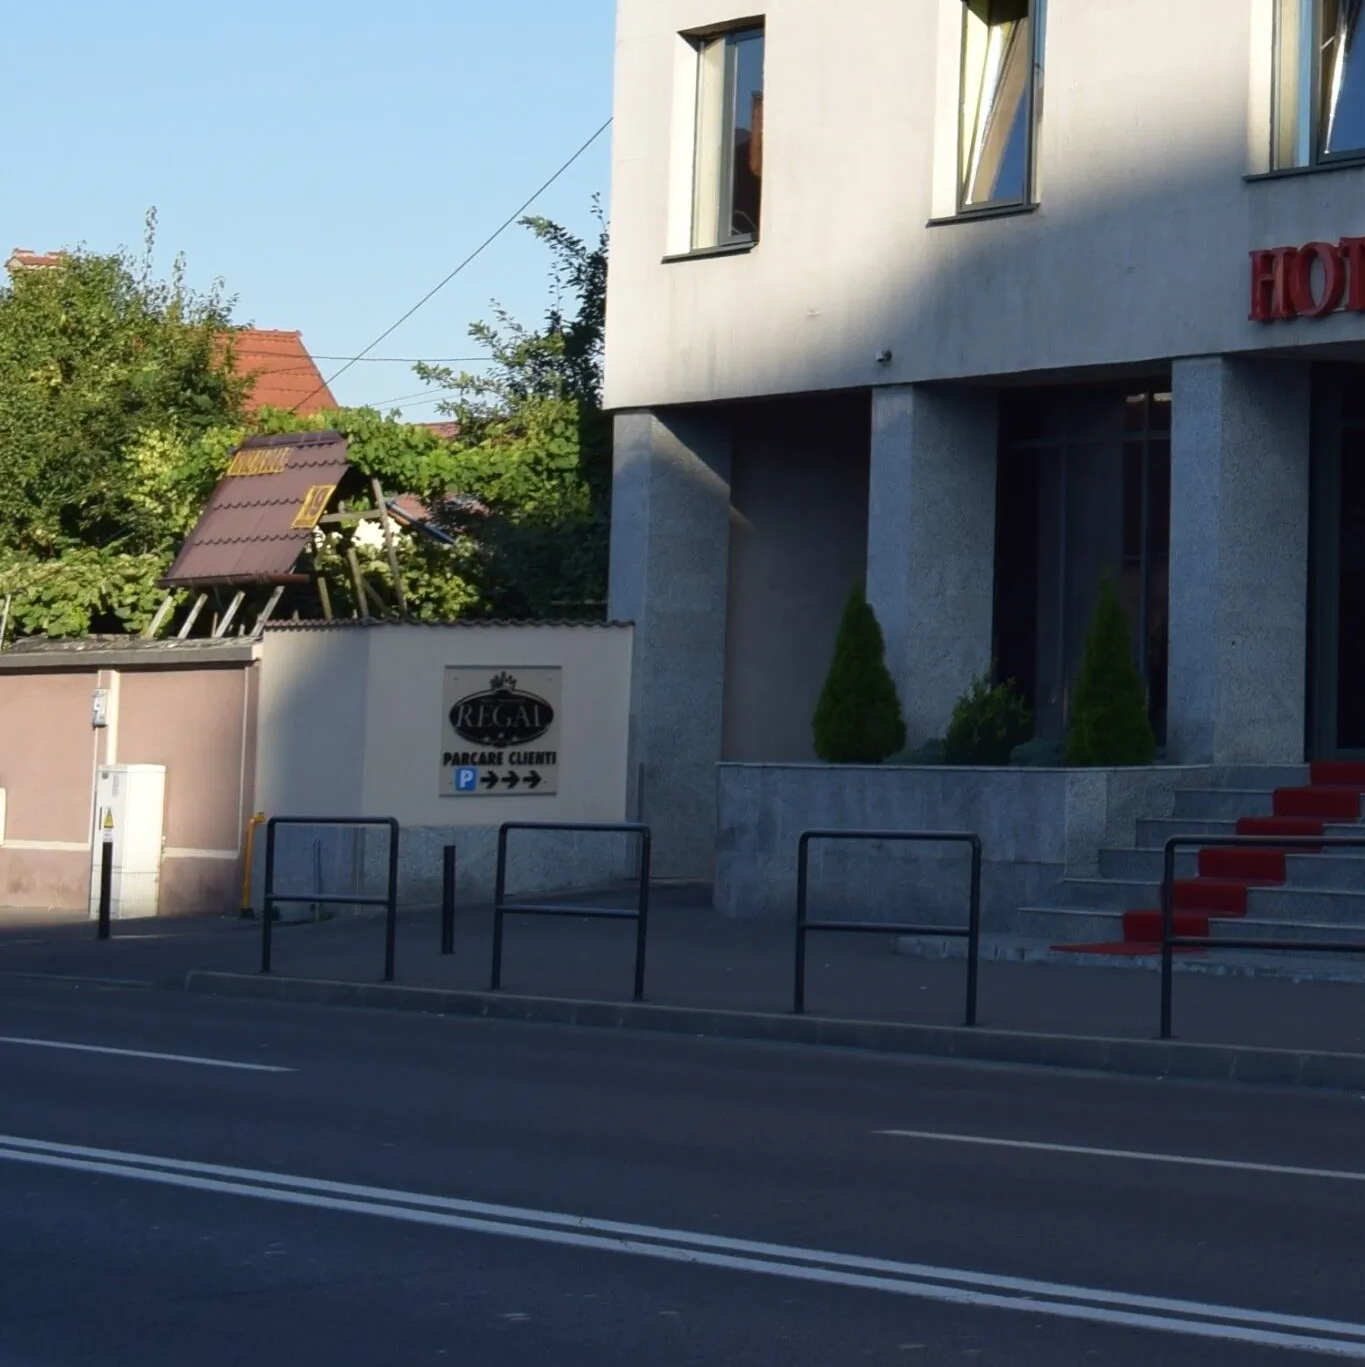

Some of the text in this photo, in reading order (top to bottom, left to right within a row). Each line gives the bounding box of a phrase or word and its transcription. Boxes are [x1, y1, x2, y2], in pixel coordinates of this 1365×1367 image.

[456, 703, 543, 728] REGAL
[443, 750, 557, 766] PARCARE CLIENTI
[459, 769, 474, 789] P
